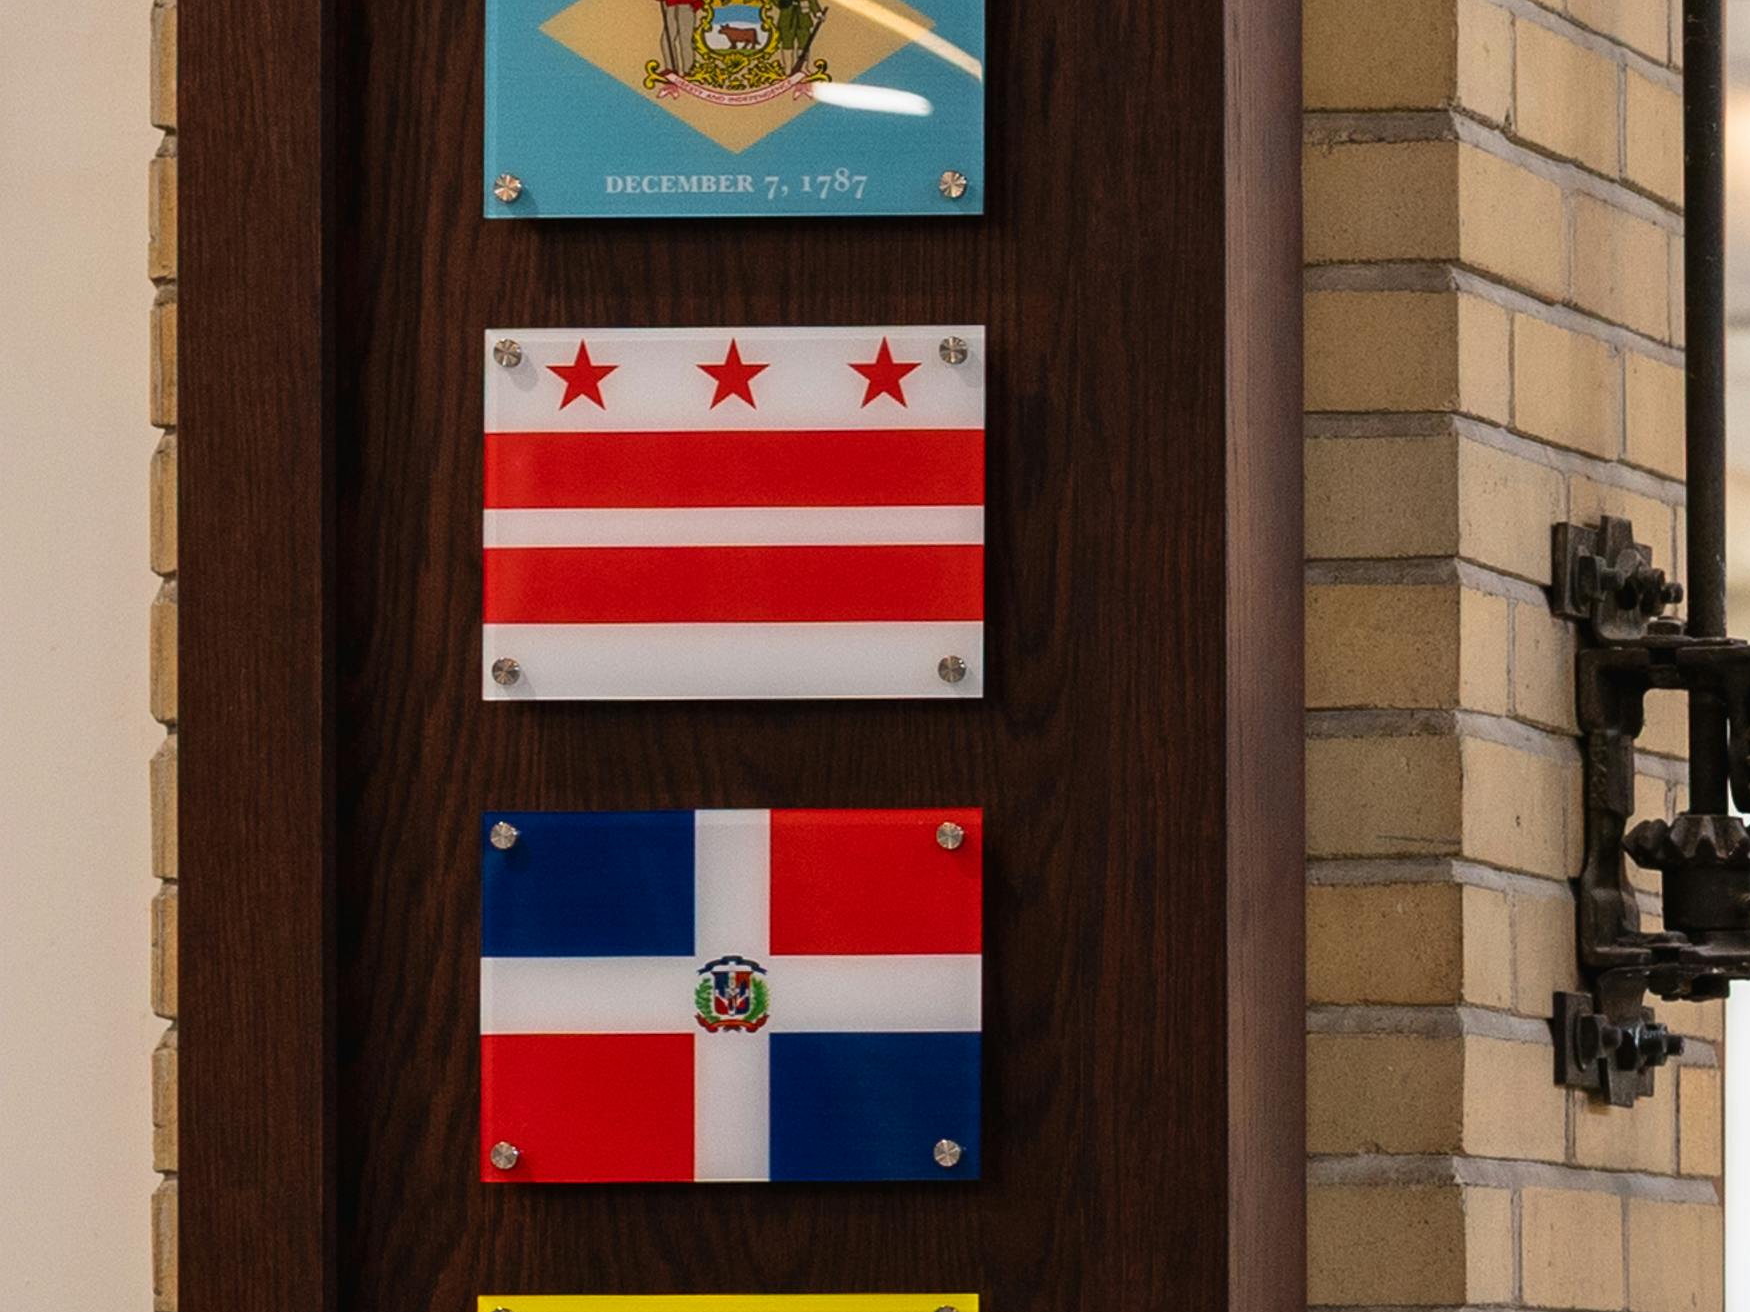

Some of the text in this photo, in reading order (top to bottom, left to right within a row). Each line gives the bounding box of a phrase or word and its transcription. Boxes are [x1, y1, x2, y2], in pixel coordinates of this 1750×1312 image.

[605, 167, 867, 199] DECEMBER 7, 1787
